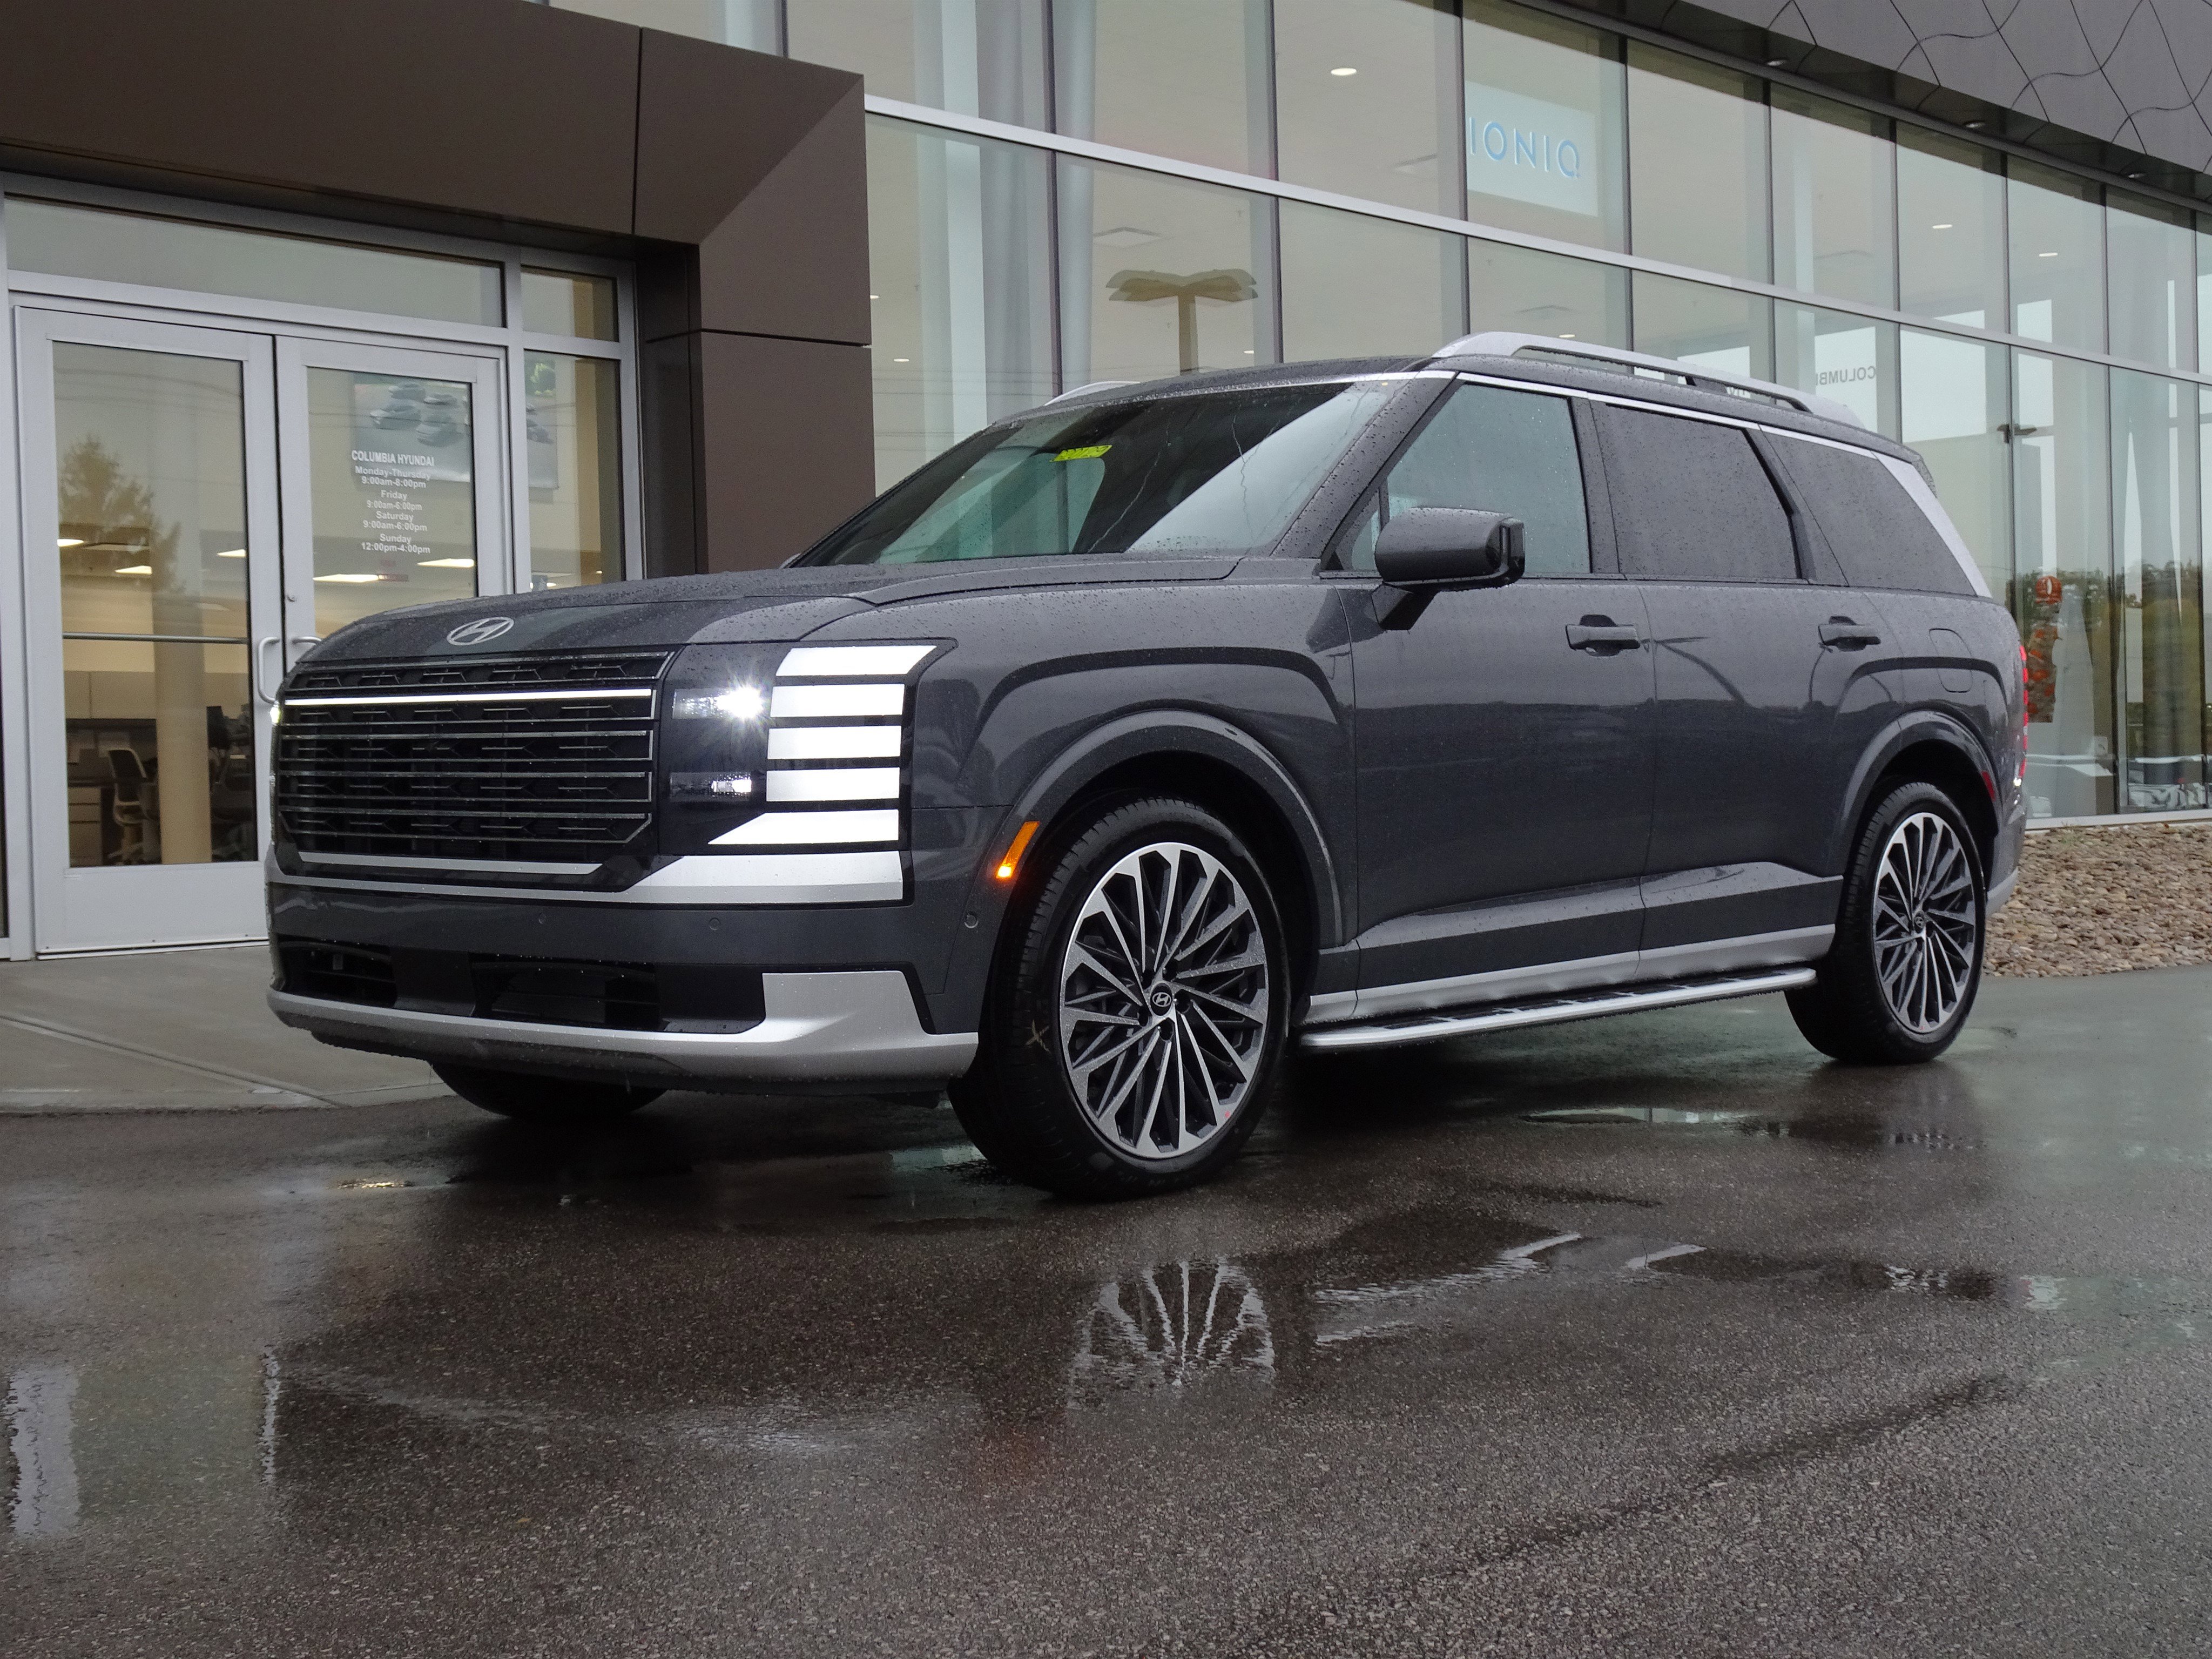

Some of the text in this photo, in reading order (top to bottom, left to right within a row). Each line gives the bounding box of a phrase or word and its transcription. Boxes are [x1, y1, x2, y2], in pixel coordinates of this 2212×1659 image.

[1469, 117, 1581, 179] IONIQ
[352, 450, 434, 467] COLUMBIA HYUNDAI
[355, 466, 431, 481] Monday-Thursday
[361, 476, 427, 489] 9:00am-8:00pm
[381, 490, 407, 501] Friday
[366, 500, 422, 512] 9:00am-6:00pm
[375, 510, 414, 522] Saturday
[362, 520, 428, 532] 9:00am-6:00pm
[379, 533, 412, 544] Sunday
[361, 542, 430, 555] 12:00pm-4:00pm
